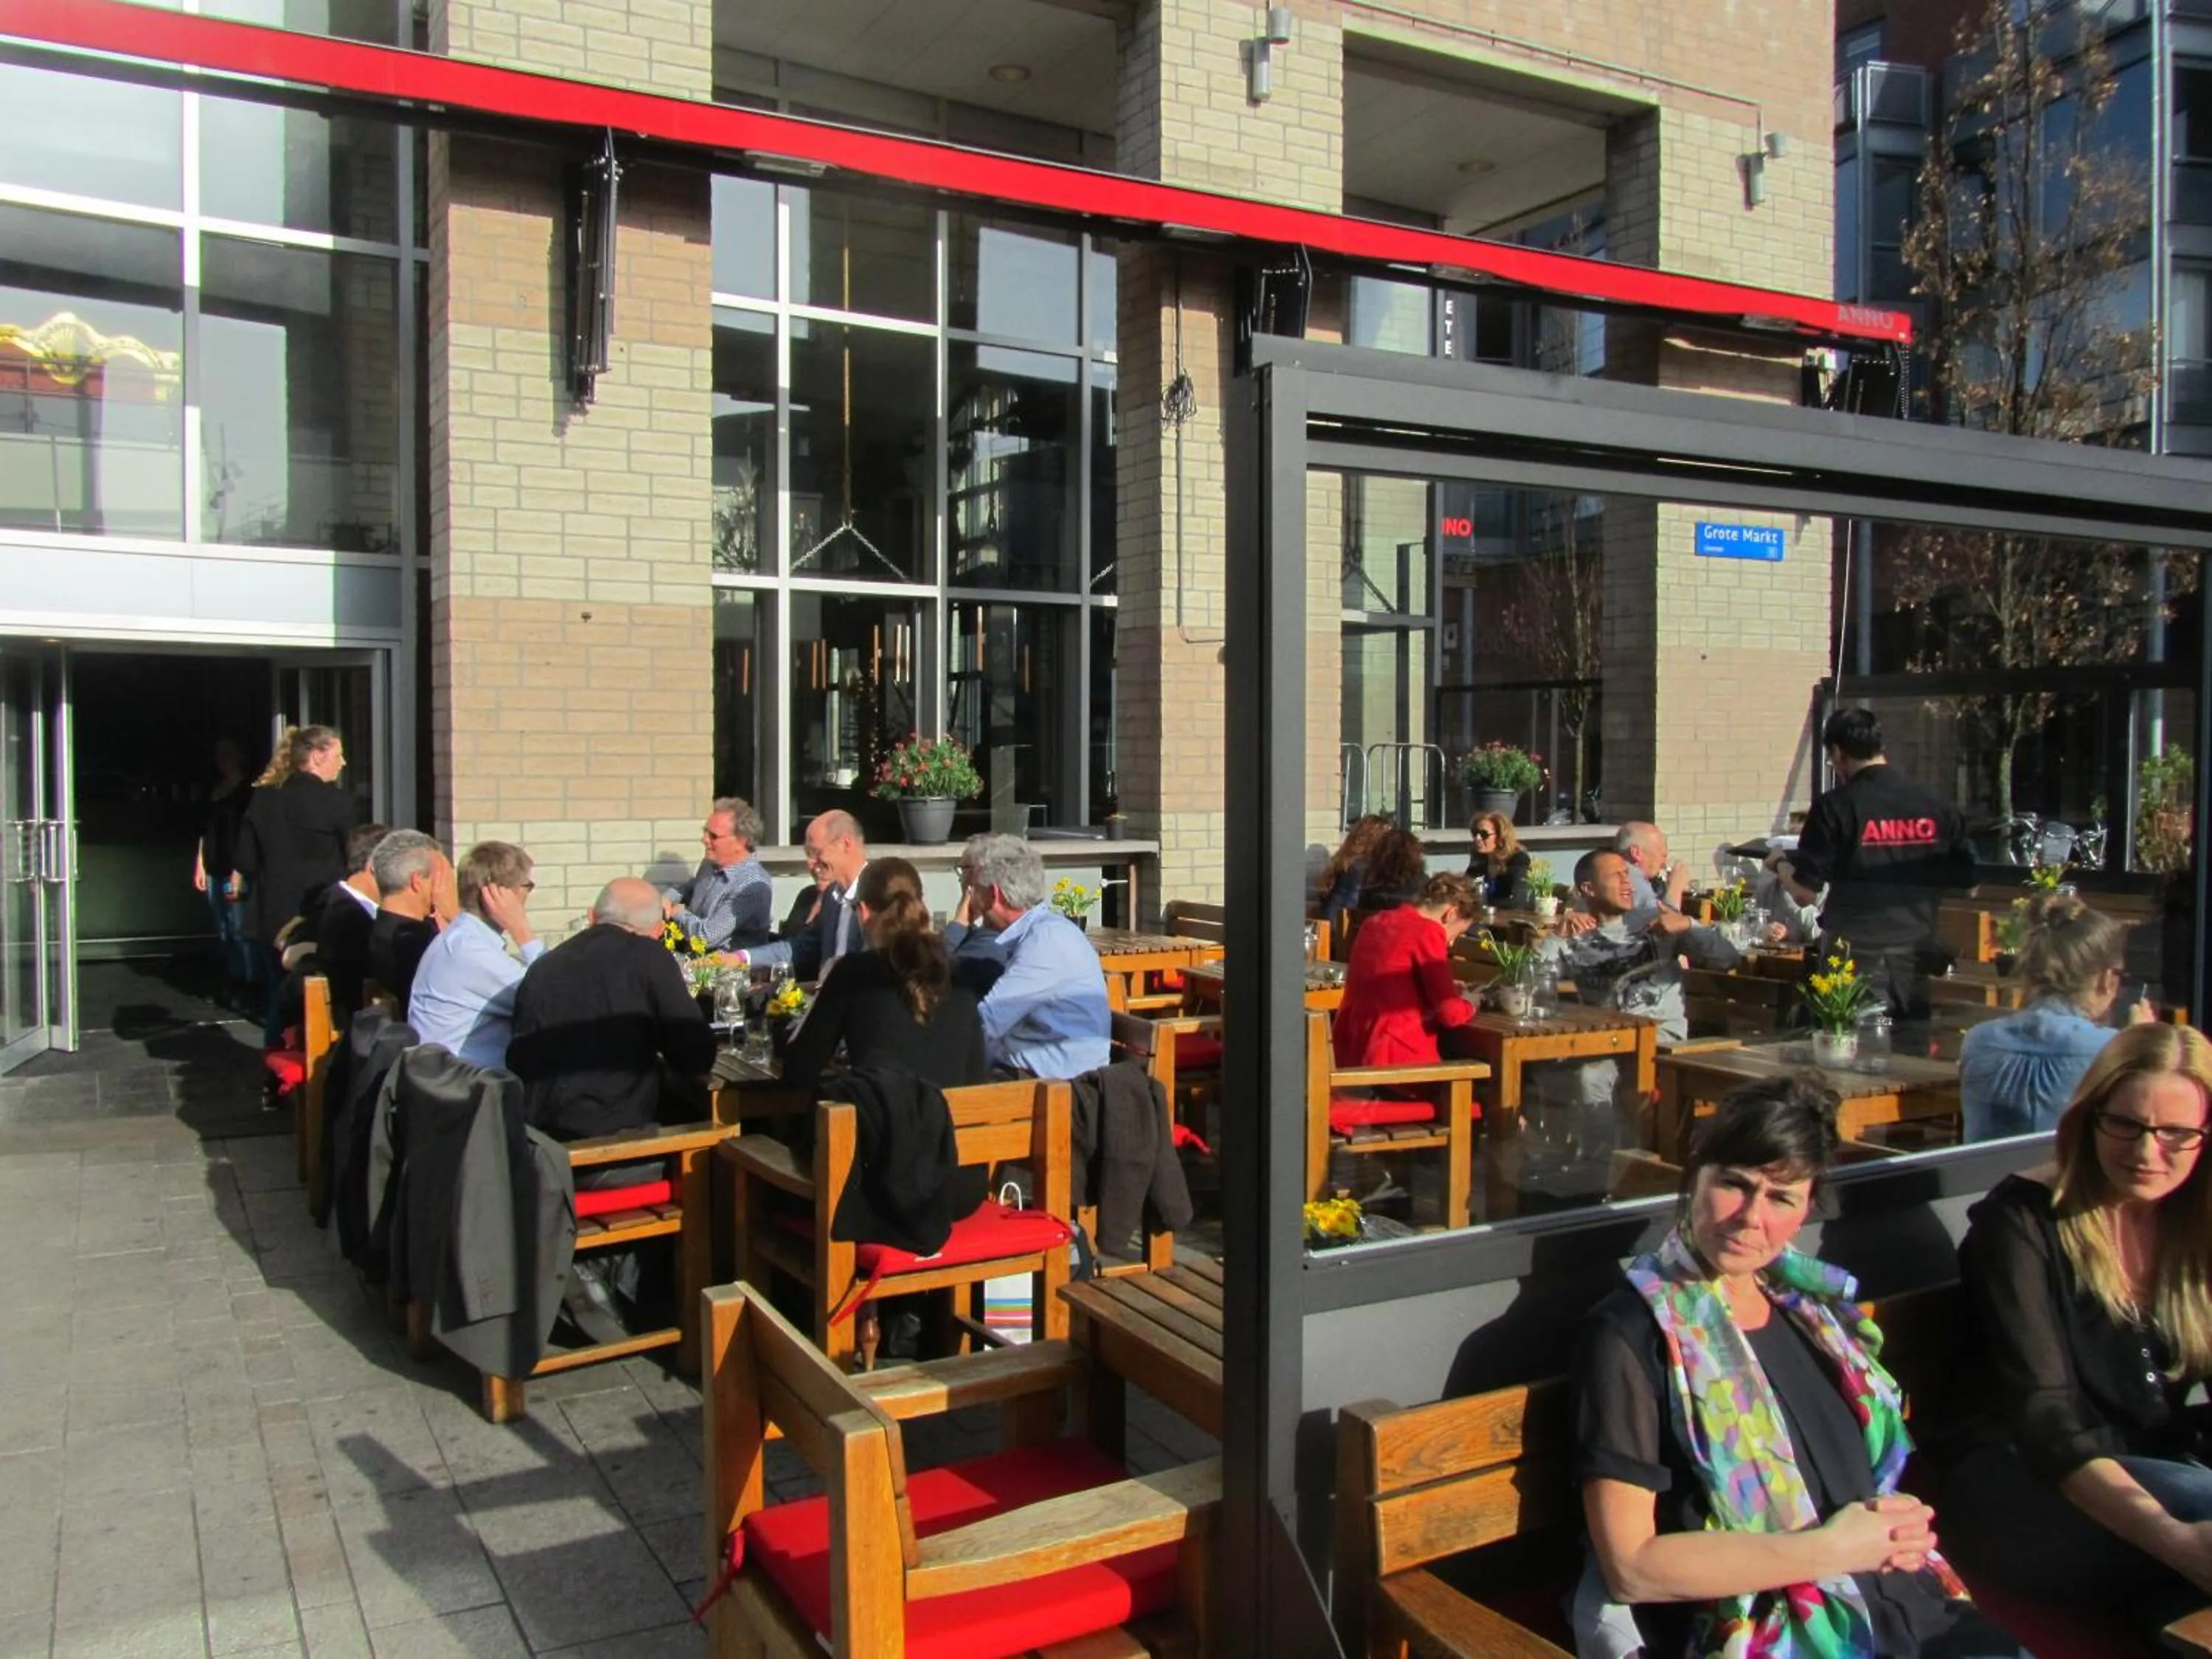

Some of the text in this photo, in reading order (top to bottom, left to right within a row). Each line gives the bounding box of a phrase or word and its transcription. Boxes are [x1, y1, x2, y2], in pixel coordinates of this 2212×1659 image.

[1838, 305, 1894, 329] ANNO
[1442, 518, 1473, 537] NO
[1704, 525, 1778, 543] Grote Markt
[1863, 818, 1936, 840] ANNO
